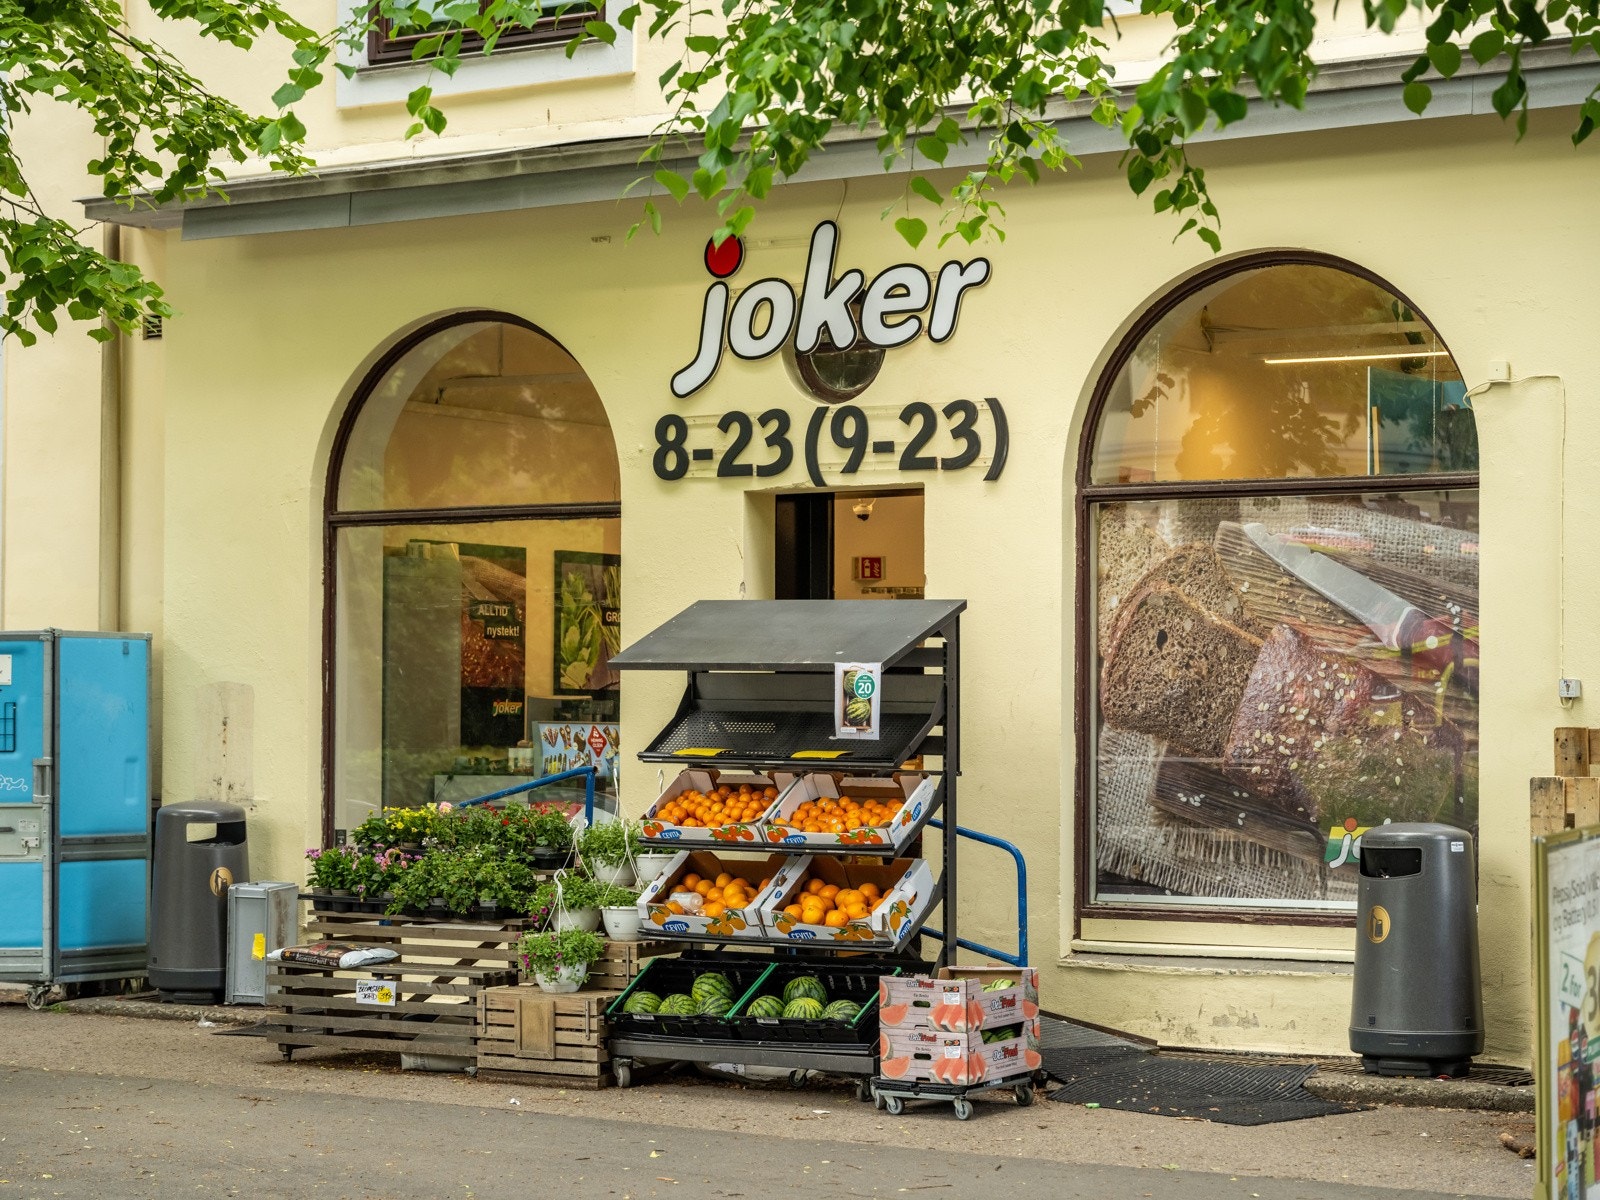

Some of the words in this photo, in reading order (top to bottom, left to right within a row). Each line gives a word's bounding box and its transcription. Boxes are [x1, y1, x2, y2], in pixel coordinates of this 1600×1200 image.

[670, 220, 992, 398] joker
[477, 604, 509, 617] ALLTID
[486, 626, 520, 638] nystekt!
[857, 682, 872, 694] 20
[492, 699, 521, 717] joker
[661, 830, 681, 839] CEVITA
[664, 922, 687, 932] CEVITA
[1561, 962, 1570, 992] 2
[1587, 965, 1600, 1022] 3
